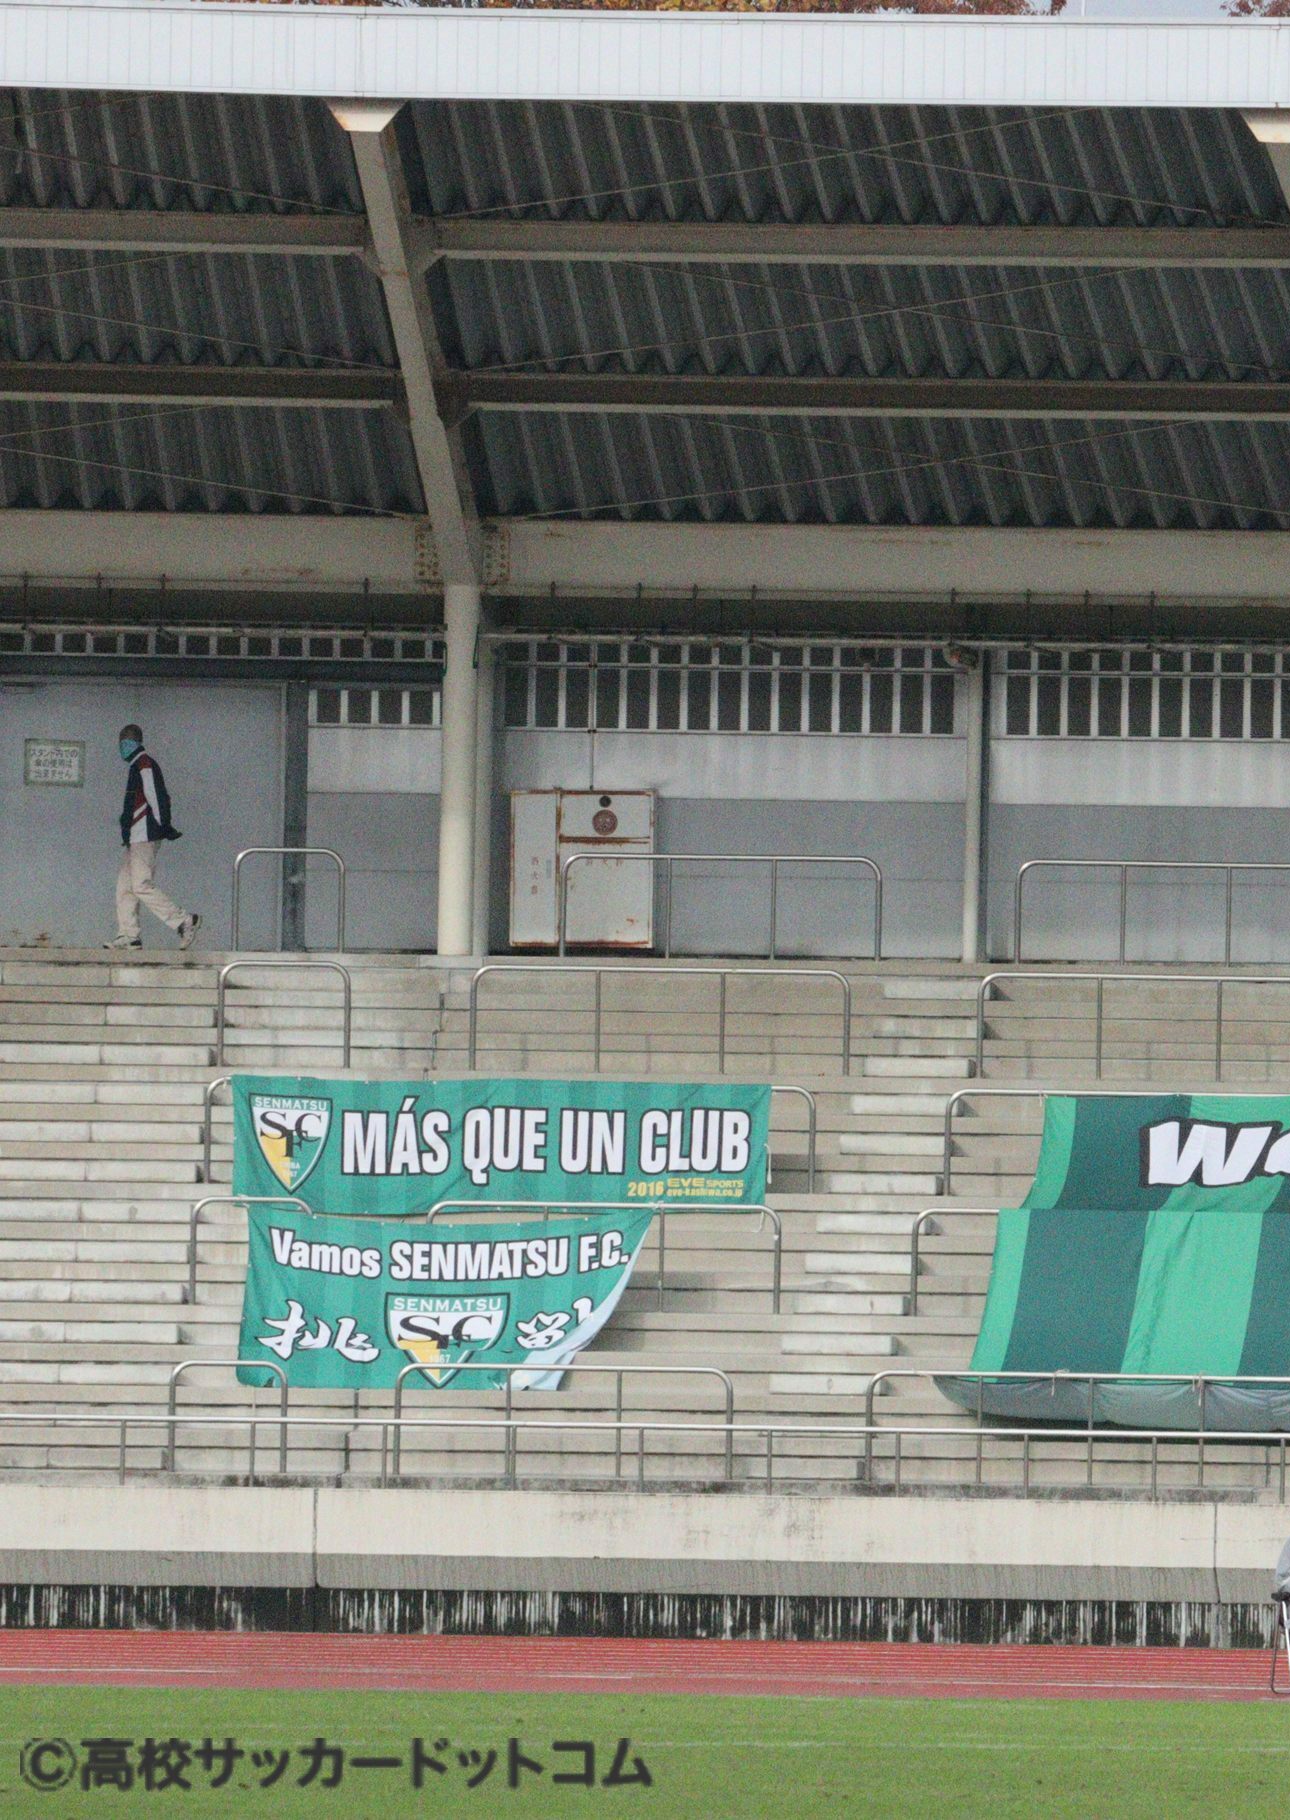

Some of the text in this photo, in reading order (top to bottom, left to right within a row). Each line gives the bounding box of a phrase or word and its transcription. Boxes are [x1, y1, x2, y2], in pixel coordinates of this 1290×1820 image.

[254, 1097, 328, 1111] SENMATSU
[342, 1096, 752, 1186] MÁS QUE UN CLUB
[628, 1178, 744, 1197] 2016 EVE SPORTS
[269, 1226, 631, 1282] Vamos SENMATSU F.C.
[394, 1297, 502, 1312] SENMATSU
